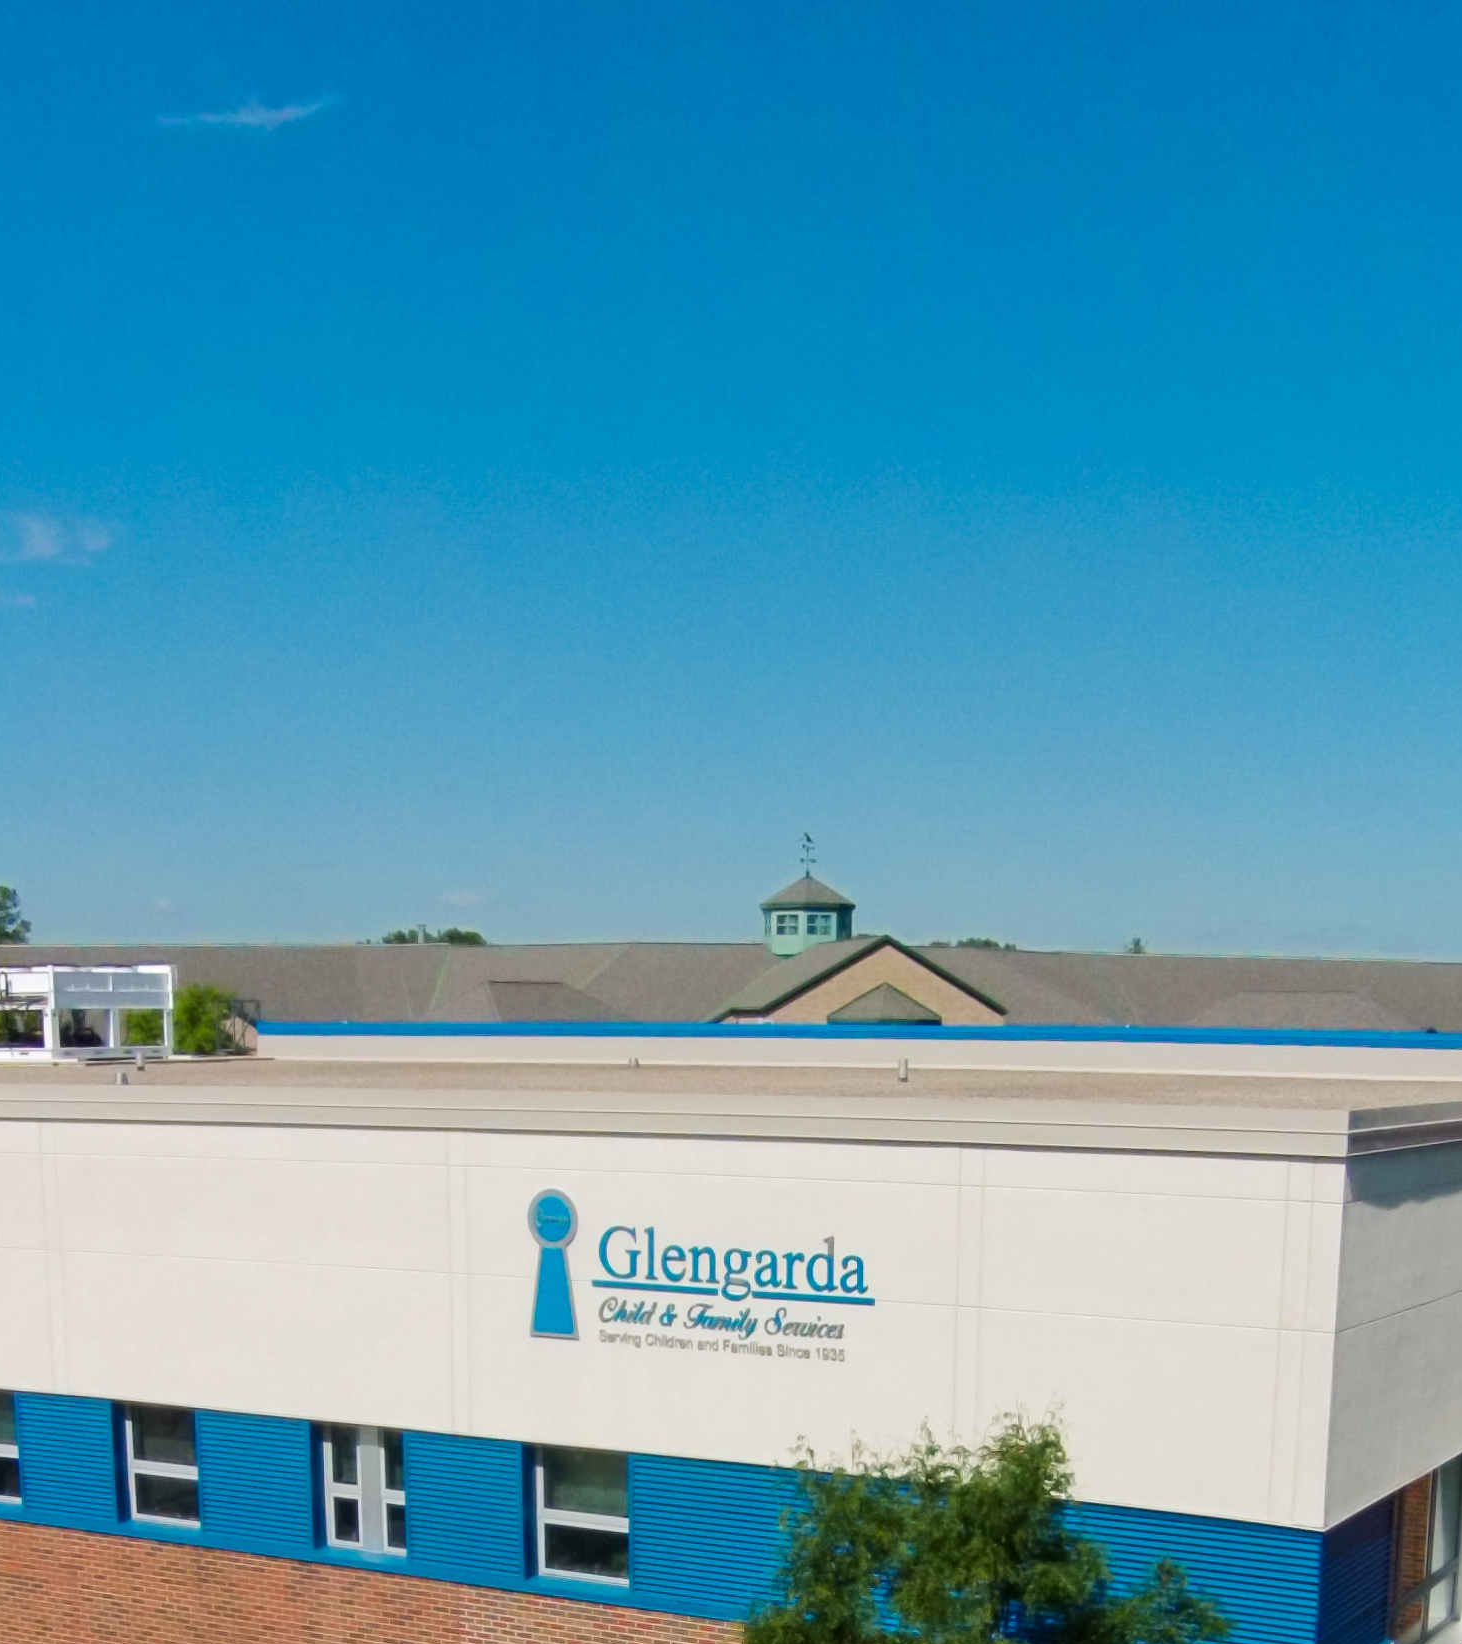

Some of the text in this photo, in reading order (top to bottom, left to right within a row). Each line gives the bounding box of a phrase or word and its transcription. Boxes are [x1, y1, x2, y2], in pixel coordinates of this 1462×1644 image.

[599, 1225, 868, 1302] Glengarda
[598, 1296, 845, 1341] Child & Family Services
[599, 1329, 641, 1348] Serving
[645, 1333, 693, 1350] Children
[697, 1338, 719, 1352] and
[723, 1339, 772, 1357] Families
[776, 1344, 810, 1360] Since
